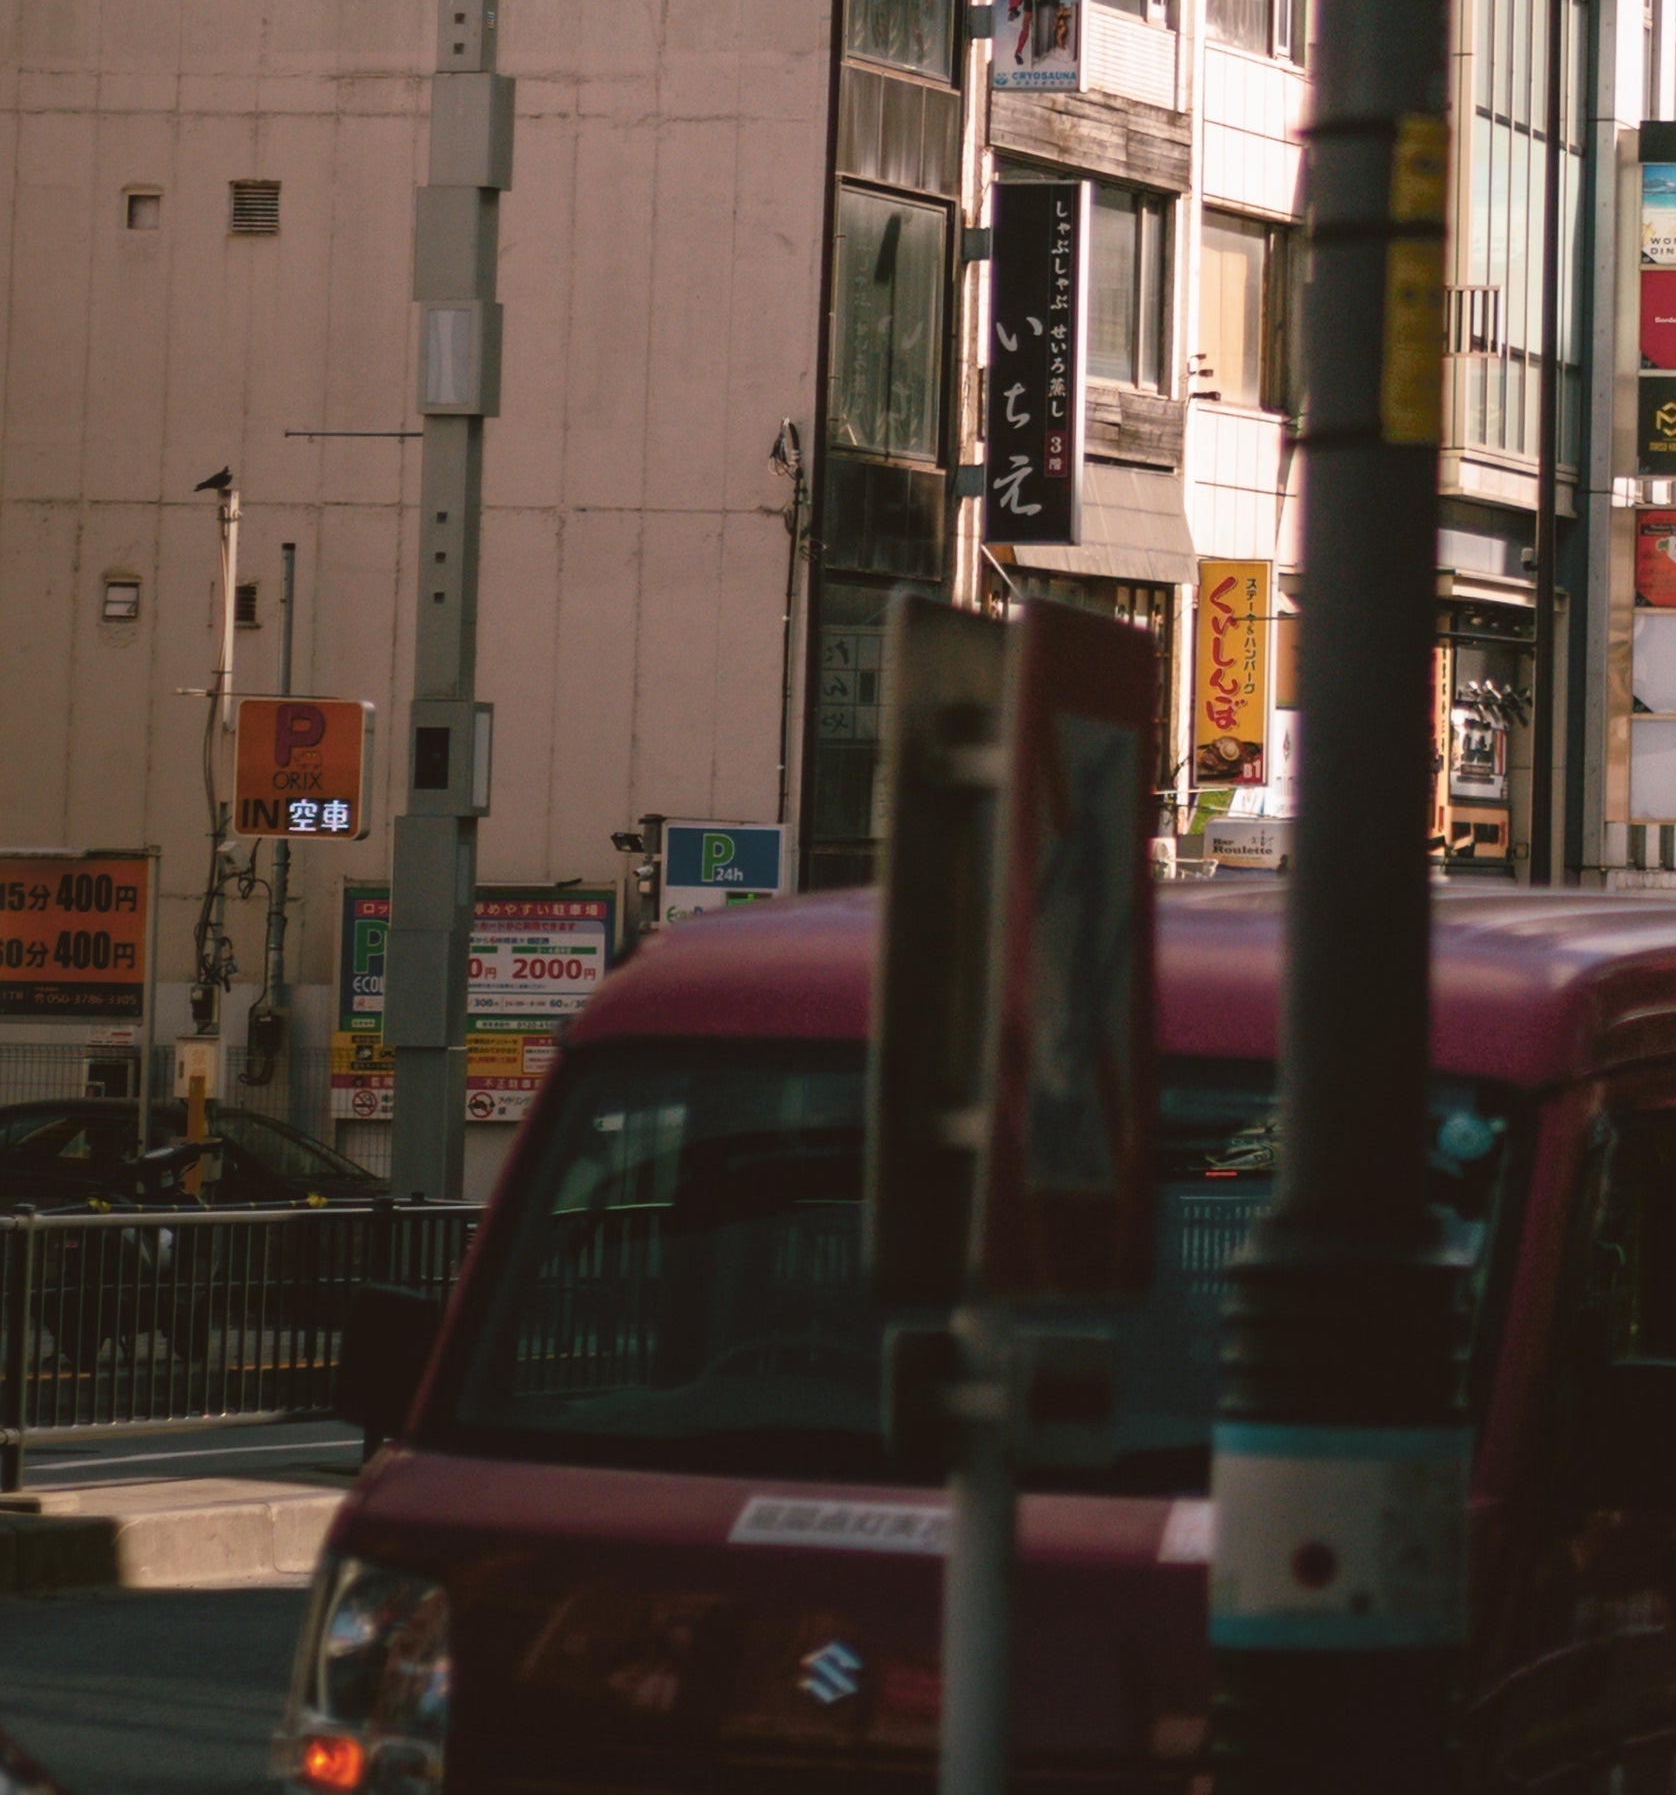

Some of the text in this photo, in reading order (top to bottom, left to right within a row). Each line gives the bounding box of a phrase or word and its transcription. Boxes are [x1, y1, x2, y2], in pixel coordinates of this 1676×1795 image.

[1012, 71, 1077, 81] CRYOSAUNA
[1051, 200, 1072, 310] しゃぶしゃぶ
[1048, 323, 1068, 419] せいろ蒸し
[993, 316, 1044, 516] いちえ
[1205, 575, 1242, 731] くいしんぼ
[274, 703, 326, 768] P
[272, 771, 323, 791] ORIX
[1243, 758, 1262, 779] B1
[241, 798, 280, 830] IN
[289, 798, 350, 832] 空車
[701, 832, 736, 883] P
[1212, 845, 1273, 856] Roulette
[715, 866, 744, 882] 24h
[56, 873, 138, 913] 400円
[0, 930, 136, 970] 0分 400円
[512, 957, 597, 980] 2000円
